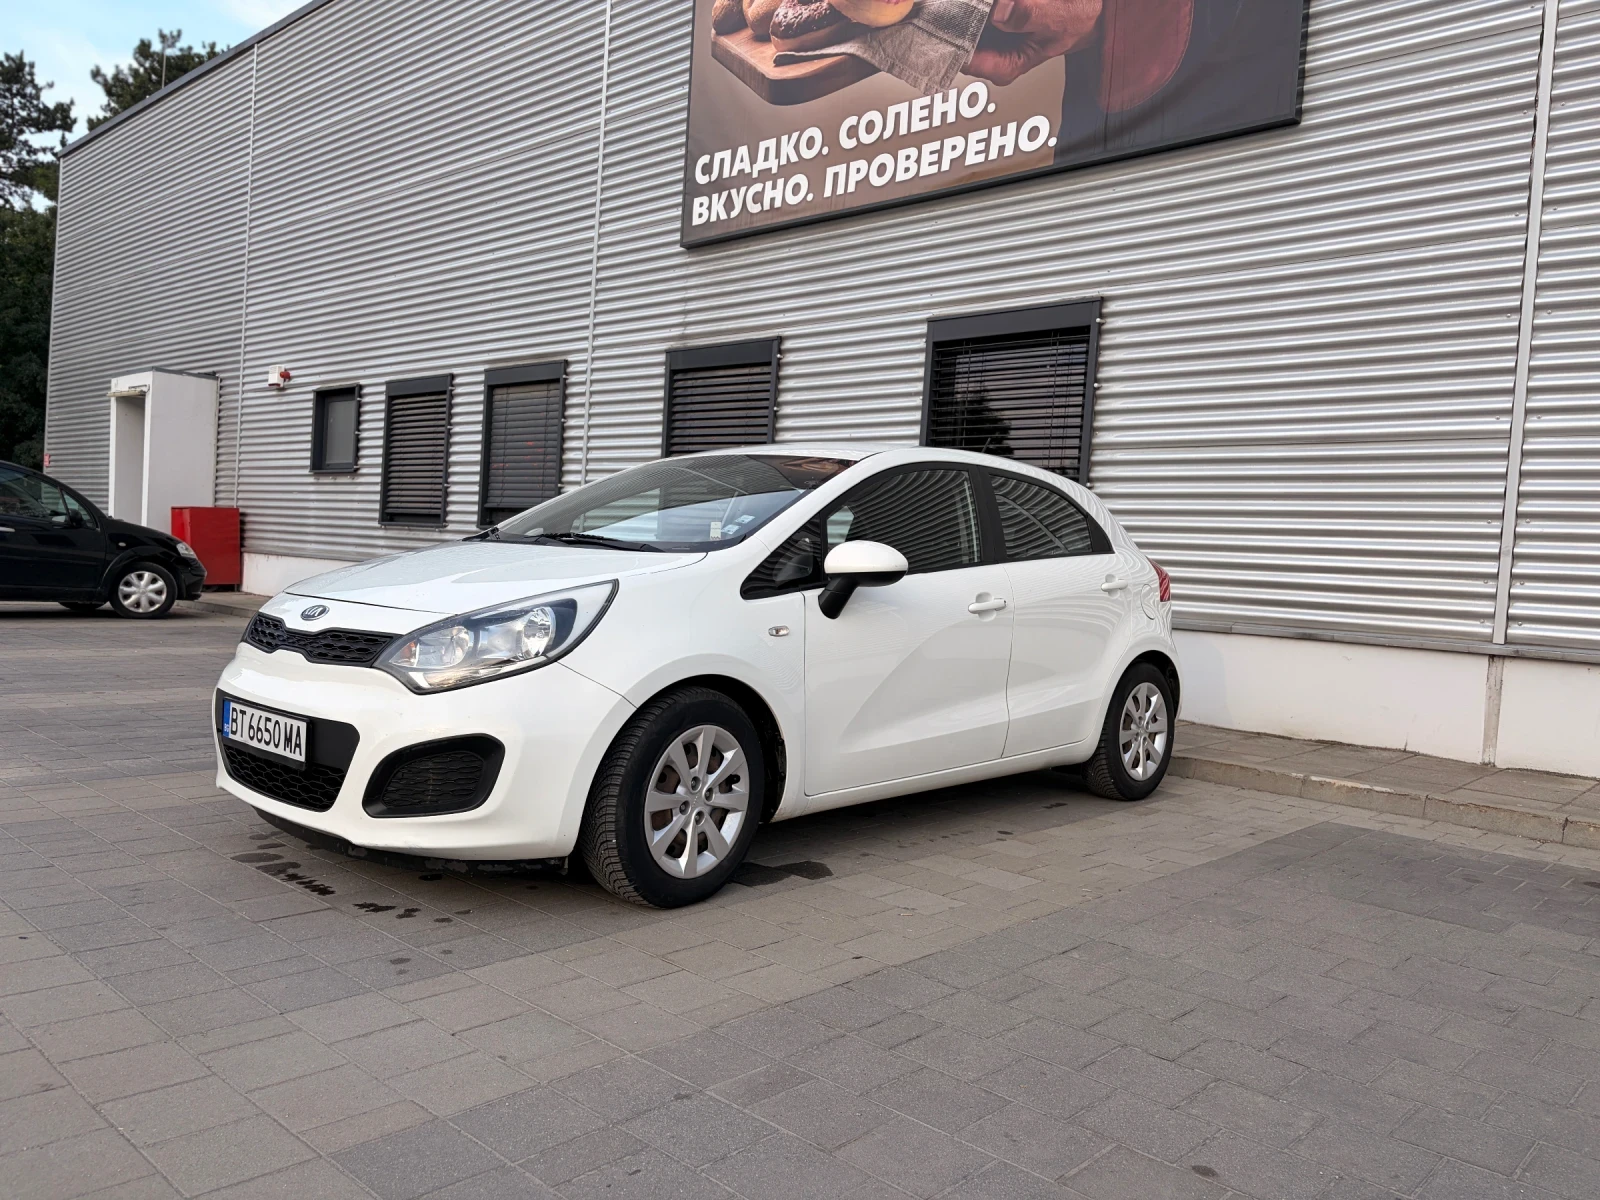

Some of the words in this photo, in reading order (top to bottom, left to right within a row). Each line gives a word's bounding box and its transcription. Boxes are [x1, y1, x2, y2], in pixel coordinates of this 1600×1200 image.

[691, 173, 814, 226] ВКУСНО.
[823, 115, 1058, 198] ПРОВЕРЕНО.
[695, 126, 829, 185] СЛАДКО.
[839, 81, 996, 149] СОЛЕНО.
